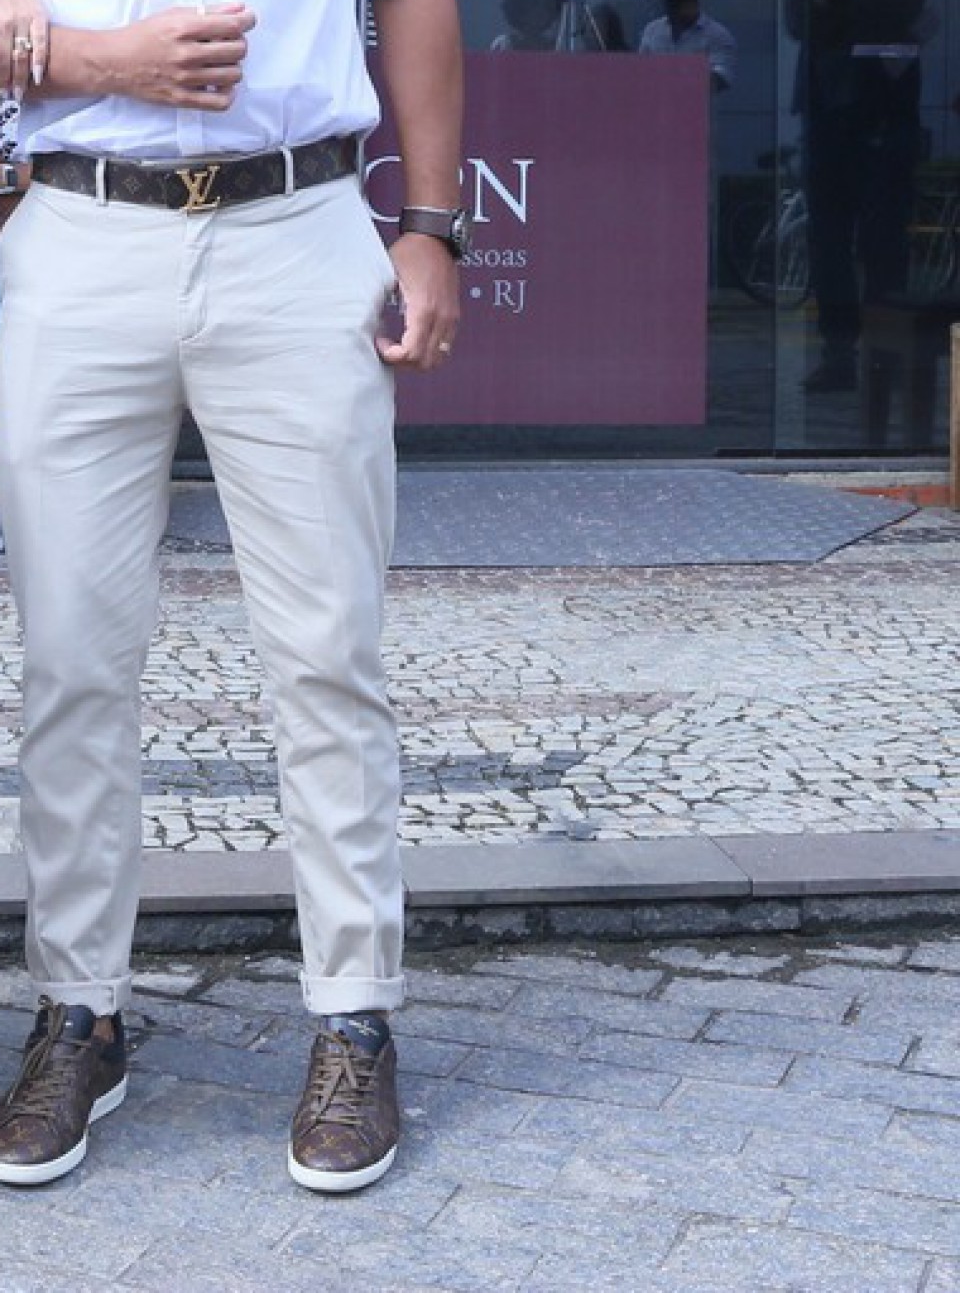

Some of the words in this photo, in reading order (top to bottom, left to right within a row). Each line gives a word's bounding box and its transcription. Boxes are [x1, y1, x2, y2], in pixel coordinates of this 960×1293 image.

[364, 155, 535, 223] CN
[457, 249, 528, 268] ssoas
[493, 279, 528, 314] RJ
